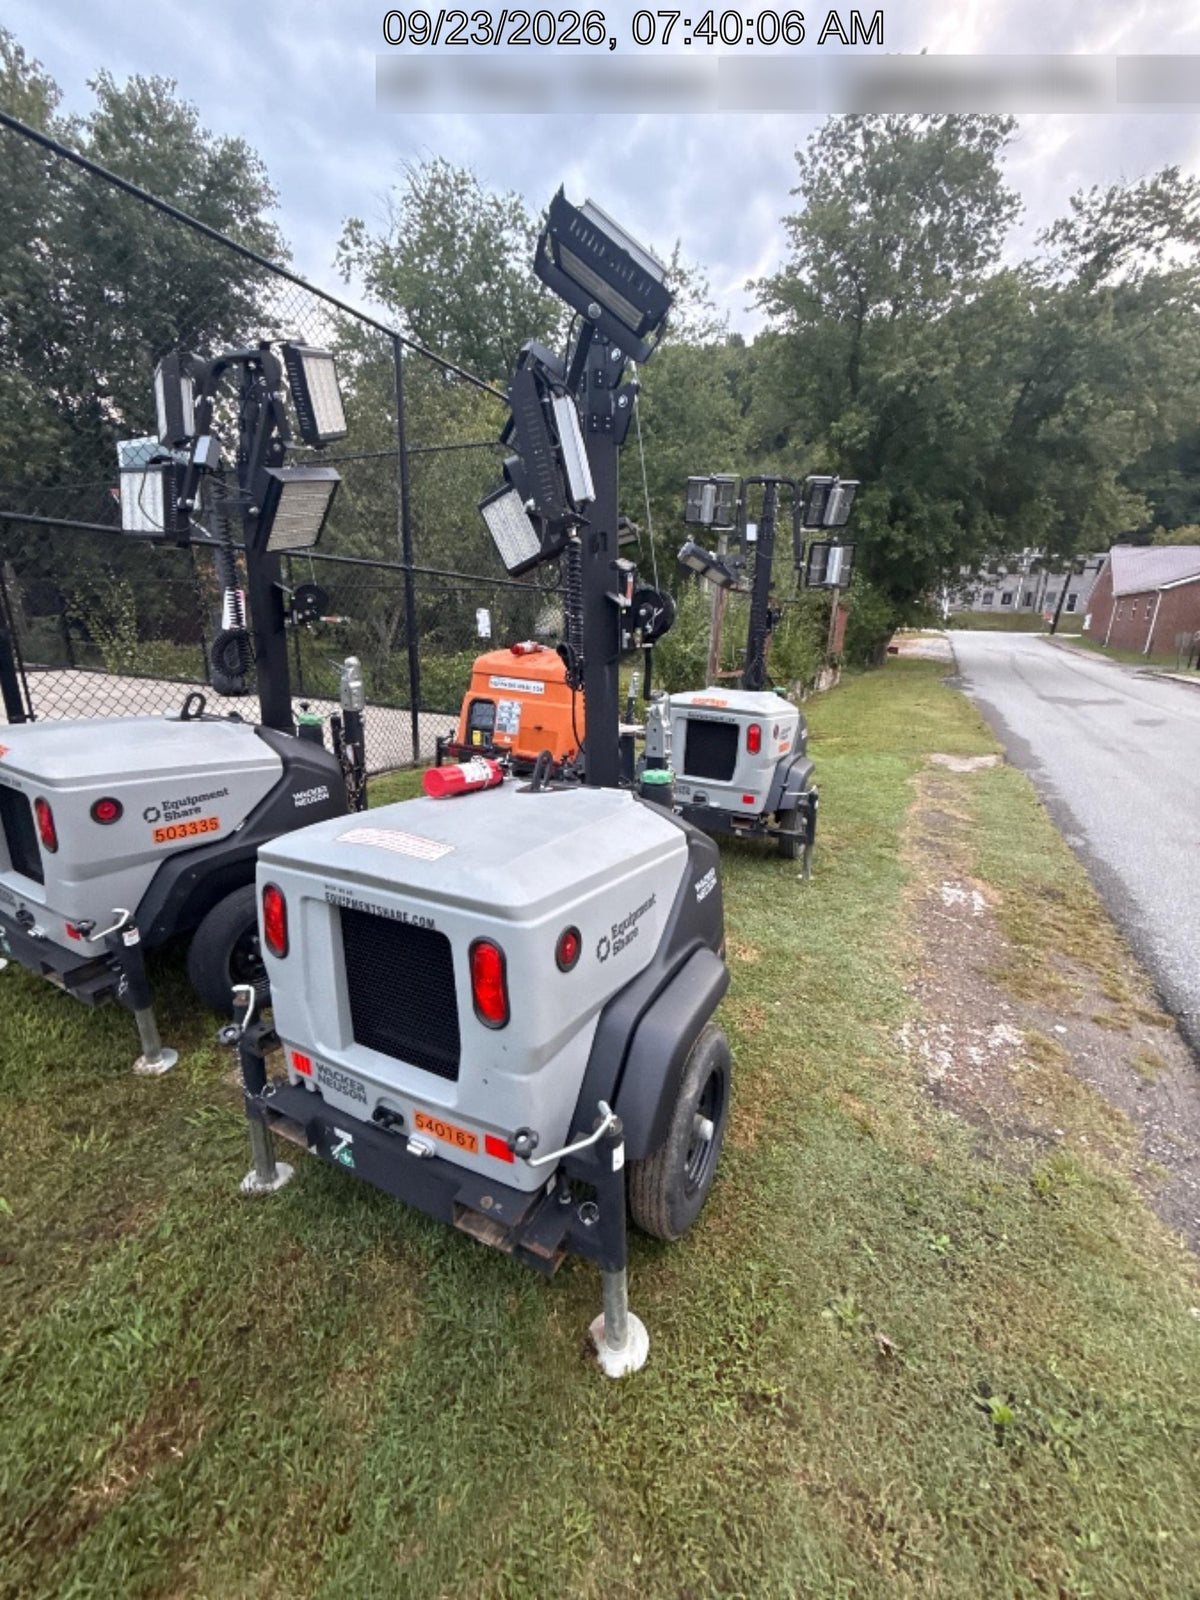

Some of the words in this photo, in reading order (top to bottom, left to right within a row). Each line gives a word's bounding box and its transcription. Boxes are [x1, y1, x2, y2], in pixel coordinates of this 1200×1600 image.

[161, 787, 230, 811] Equipment
[163, 806, 202, 822] Share
[154, 816, 220, 843] 503335
[324, 891, 436, 929] EQUIPMENTSHARE.COM
[315, 1061, 366, 1094] WACKER
[317, 1072, 368, 1104] NEUSON
[415, 1113, 477, 1150] 540167
